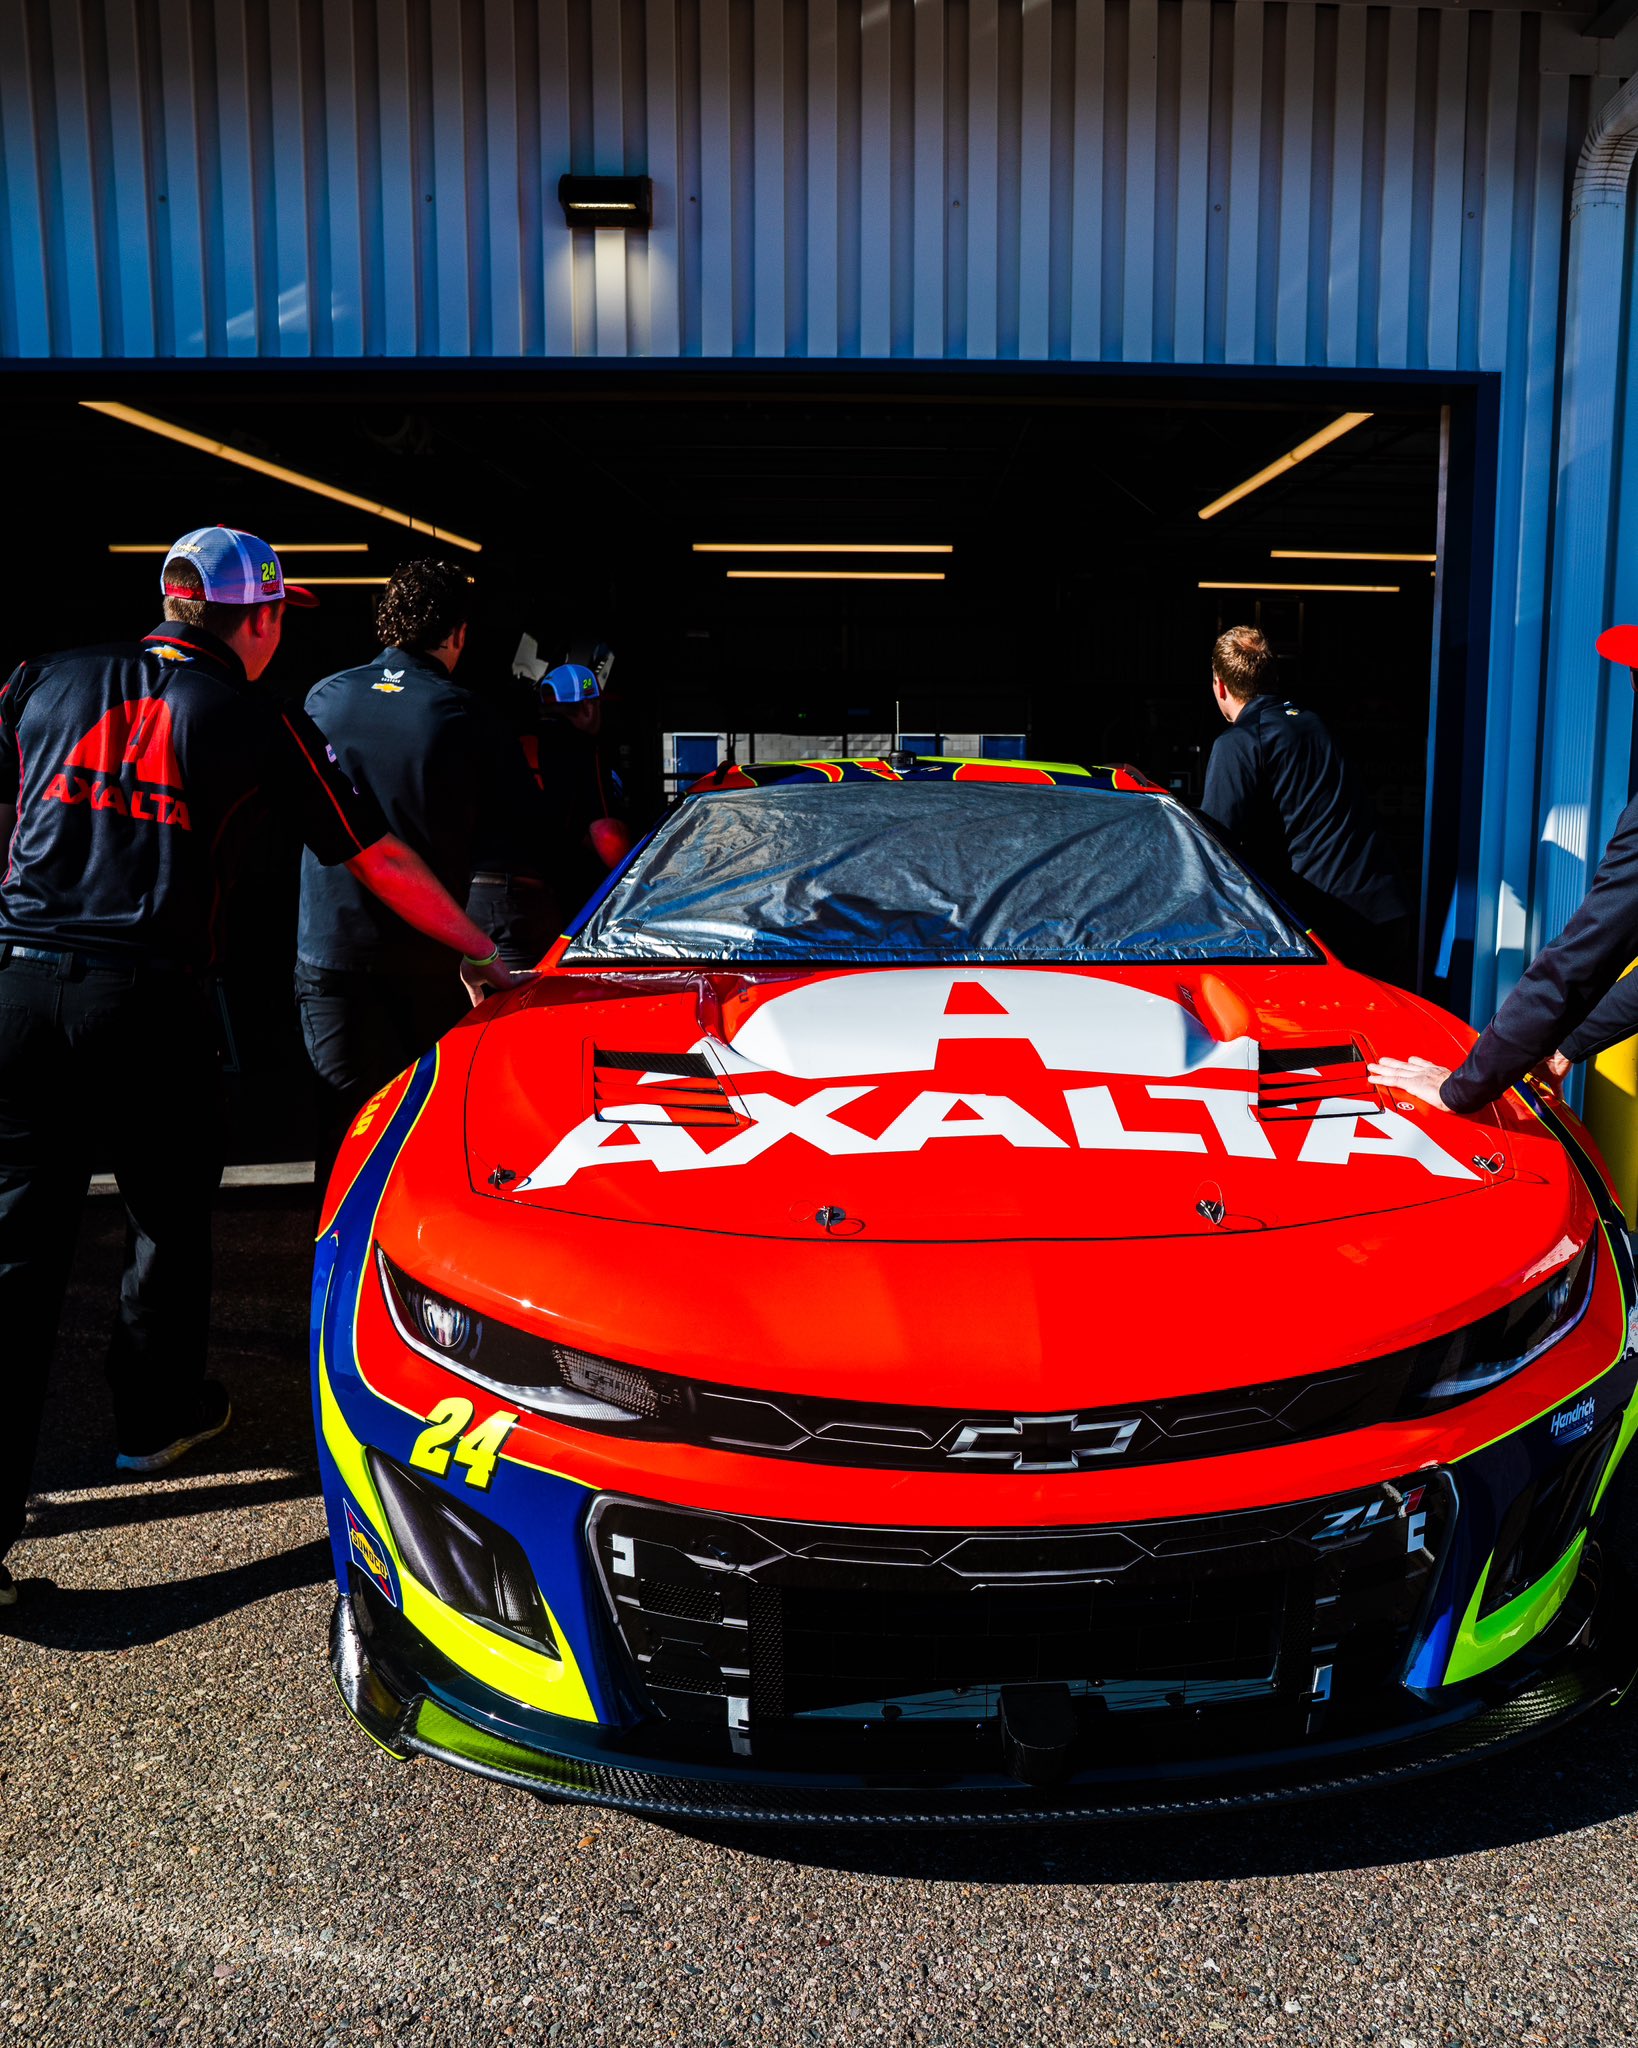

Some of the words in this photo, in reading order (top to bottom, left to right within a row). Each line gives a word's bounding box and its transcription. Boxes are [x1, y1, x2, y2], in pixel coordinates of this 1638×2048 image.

[261, 561, 276, 582] 24
[41, 773, 192, 831] AXALTA
[512, 1085, 1483, 1192] AXALTA
[1550, 1396, 1595, 1437] Hendrick
[409, 1396, 521, 1494] 24
[1311, 1485, 1427, 1541] ZL1
[352, 1531, 387, 1575] SUNOCO
